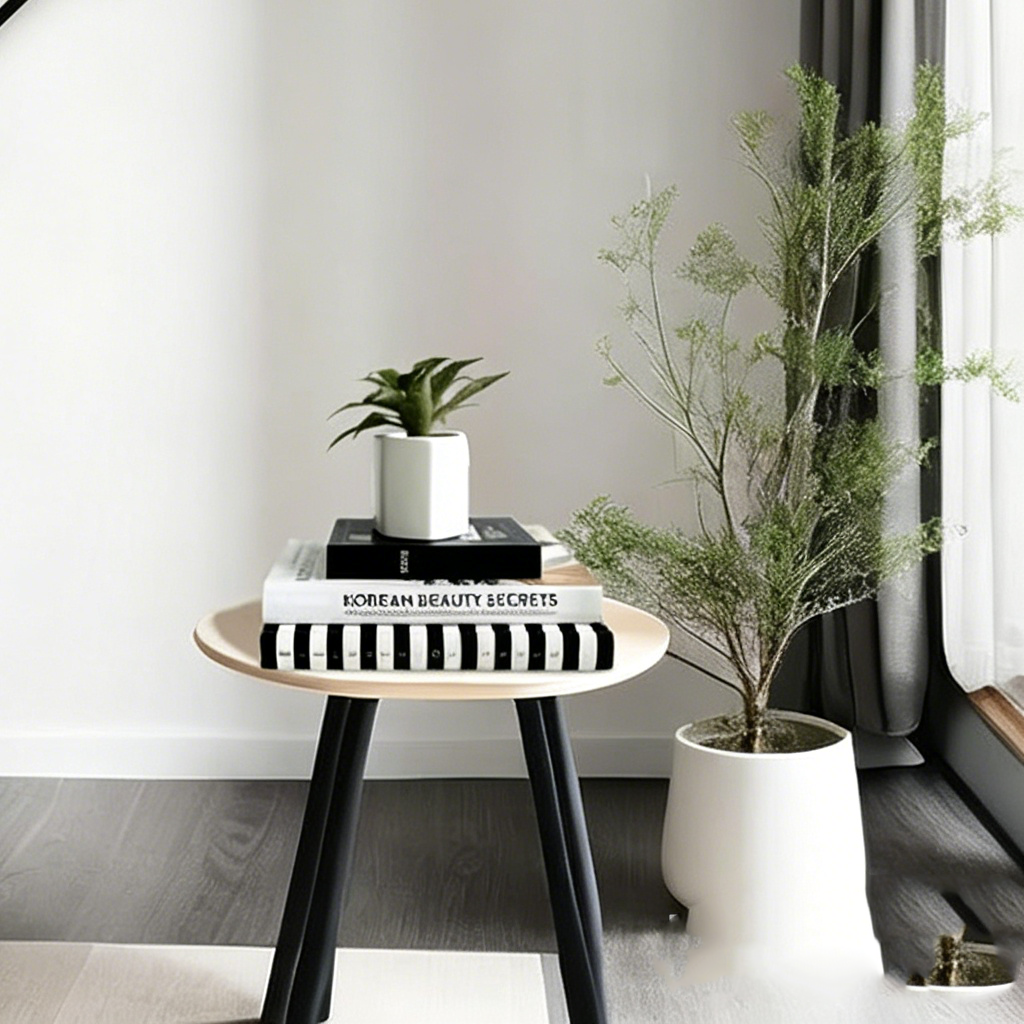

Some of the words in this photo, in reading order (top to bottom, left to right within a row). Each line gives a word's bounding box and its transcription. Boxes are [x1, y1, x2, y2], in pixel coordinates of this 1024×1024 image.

[343, 593, 414, 608] KOREAN
[418, 593, 482, 608] BEAUTY
[487, 593, 558, 608] SECRETS
